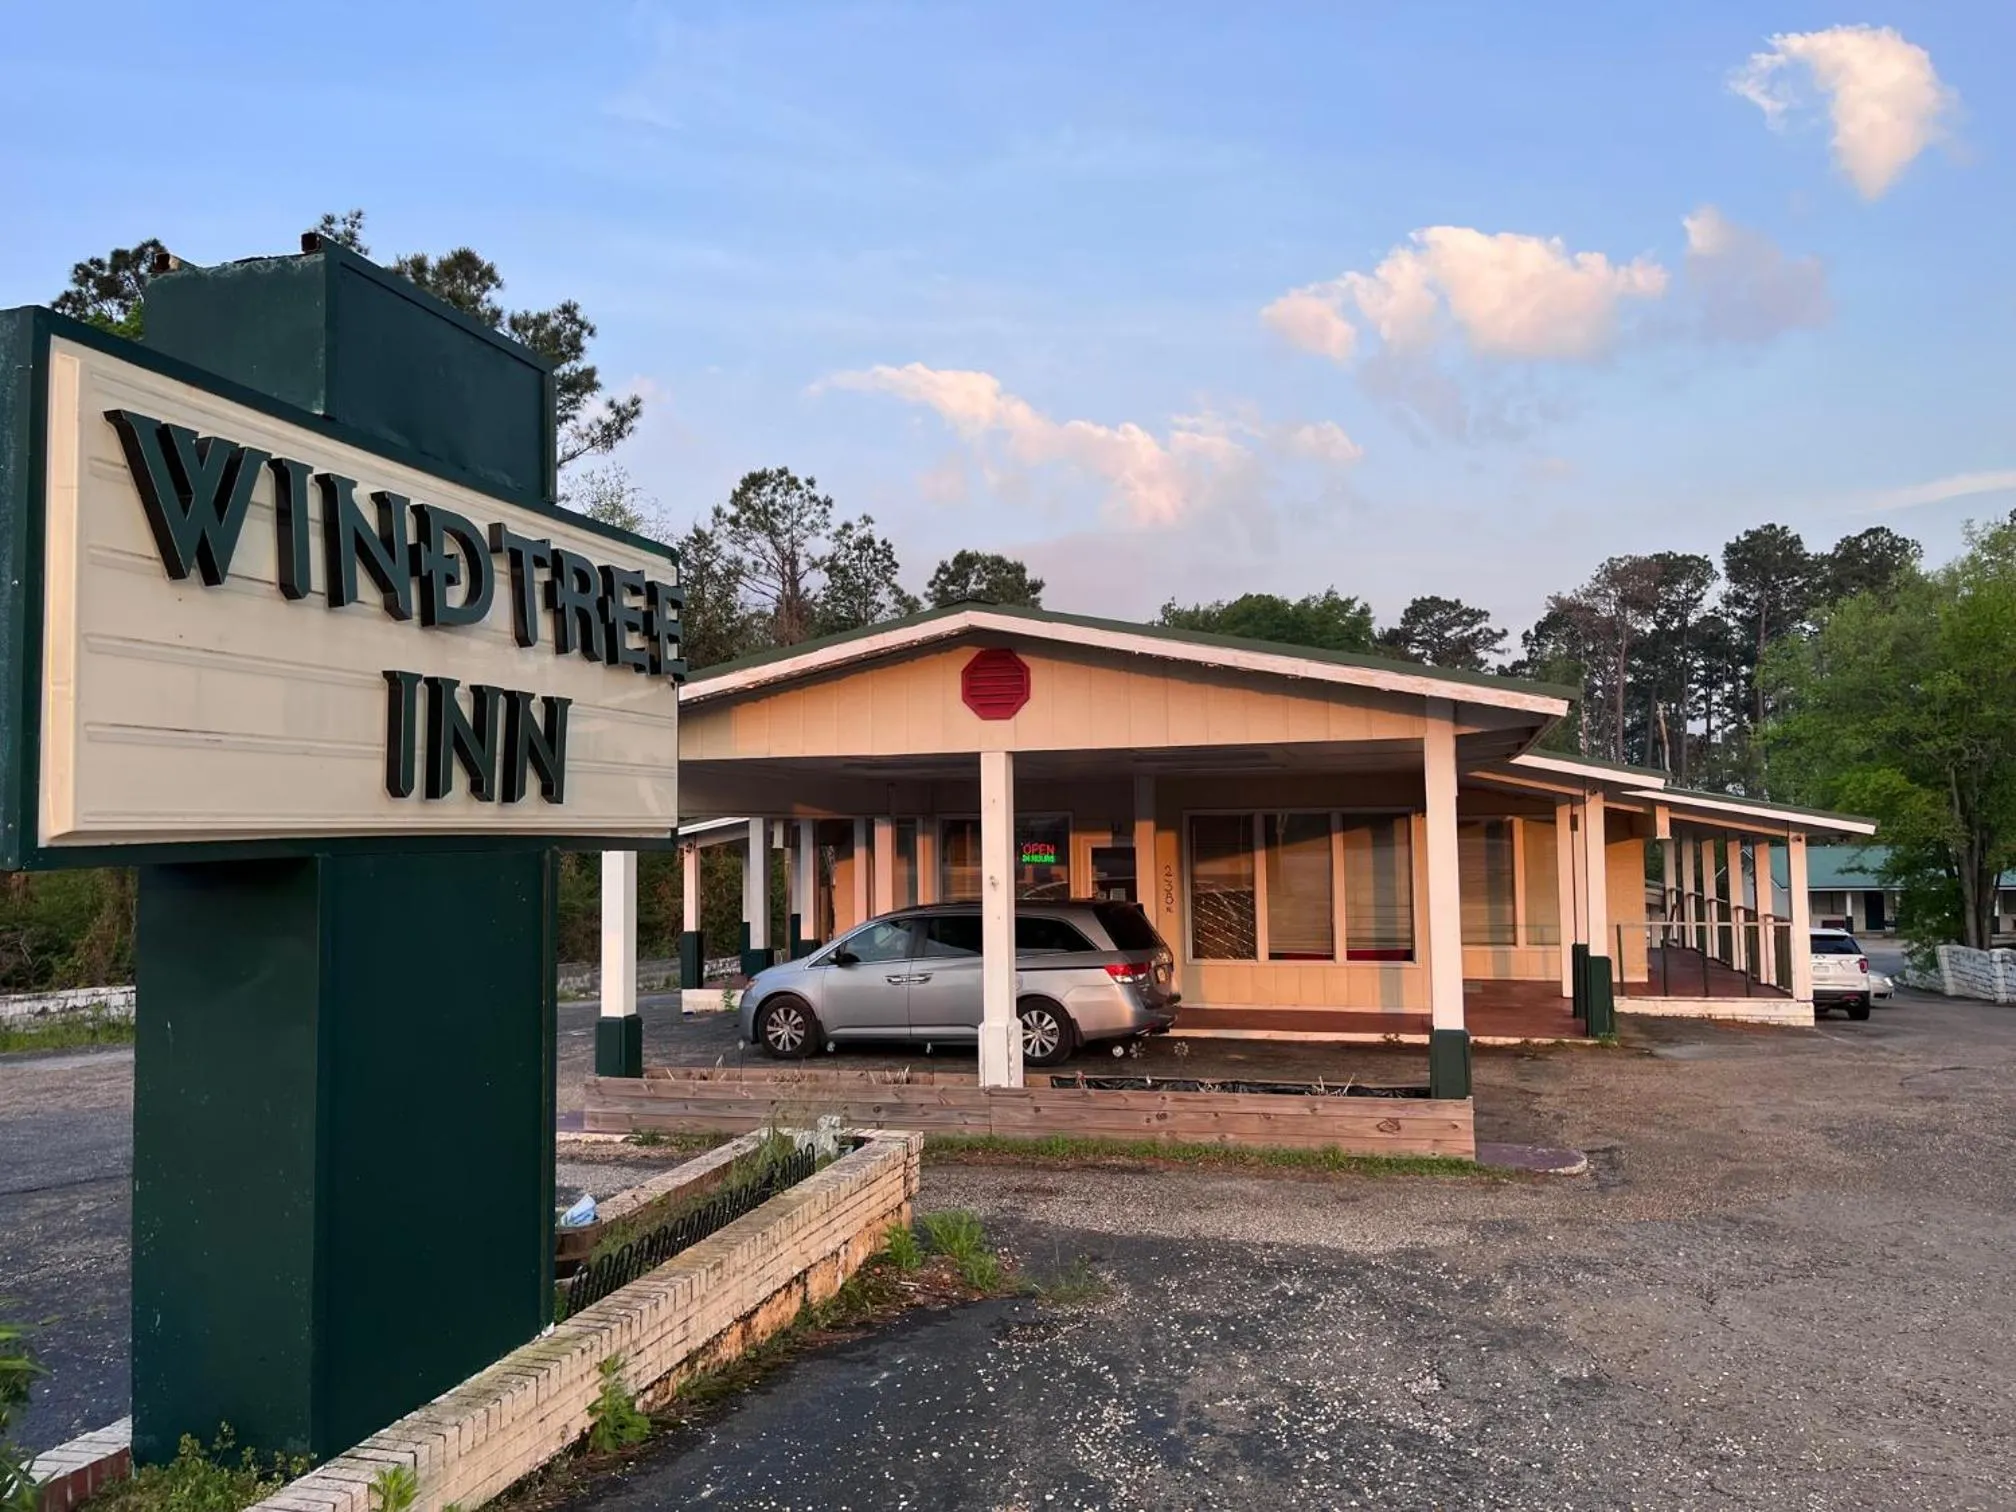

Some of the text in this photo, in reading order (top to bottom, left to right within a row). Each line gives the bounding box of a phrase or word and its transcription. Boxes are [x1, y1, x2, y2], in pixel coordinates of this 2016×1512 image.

[103, 409, 687, 682] WINDTREE
[382, 670, 573, 804] INN
[1022, 842, 1056, 856] OPEN
